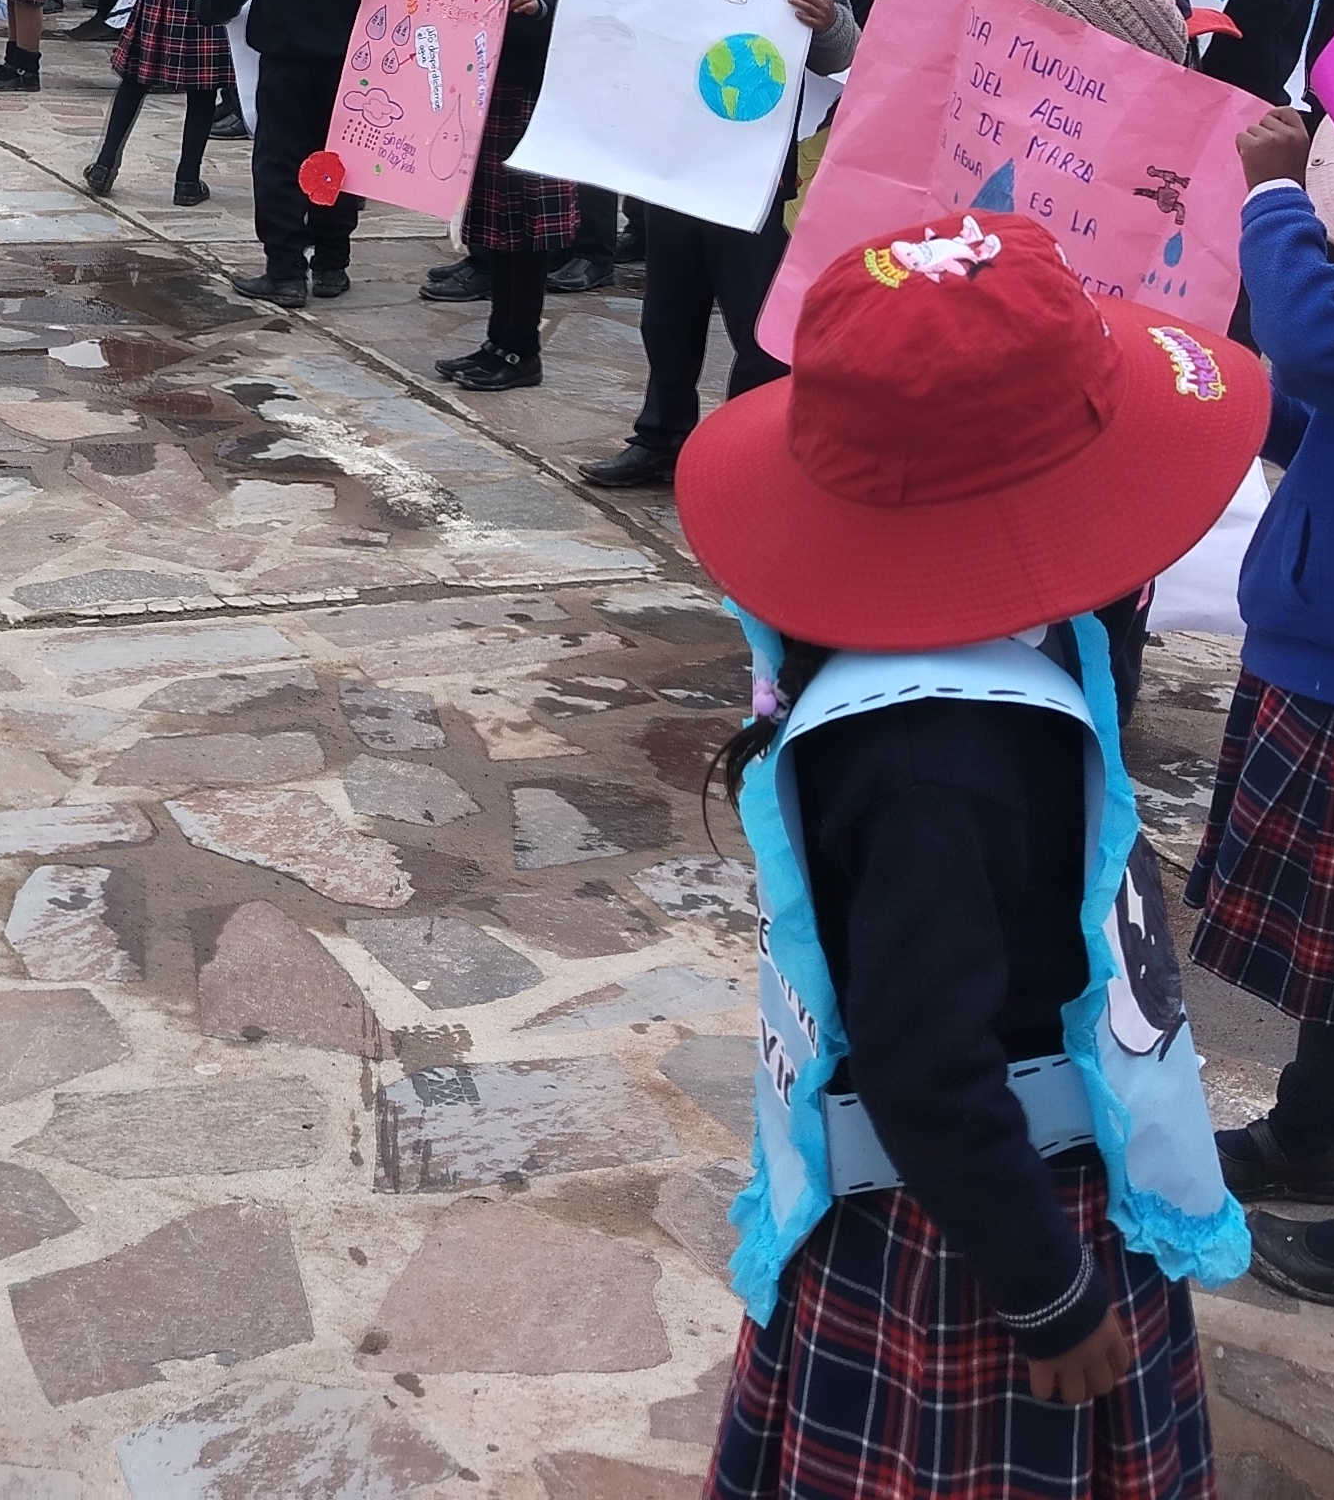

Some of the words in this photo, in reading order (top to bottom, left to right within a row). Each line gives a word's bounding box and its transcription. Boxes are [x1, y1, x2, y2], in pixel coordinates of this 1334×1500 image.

[970, 62, 1002, 98] DEL
[1030, 98, 1083, 140] AGUA
[976, 112, 1006, 146] DE
[953, 143, 983, 181] AGUA
[1030, 192, 1054, 218] ES
[1070, 209, 1097, 241] LA
